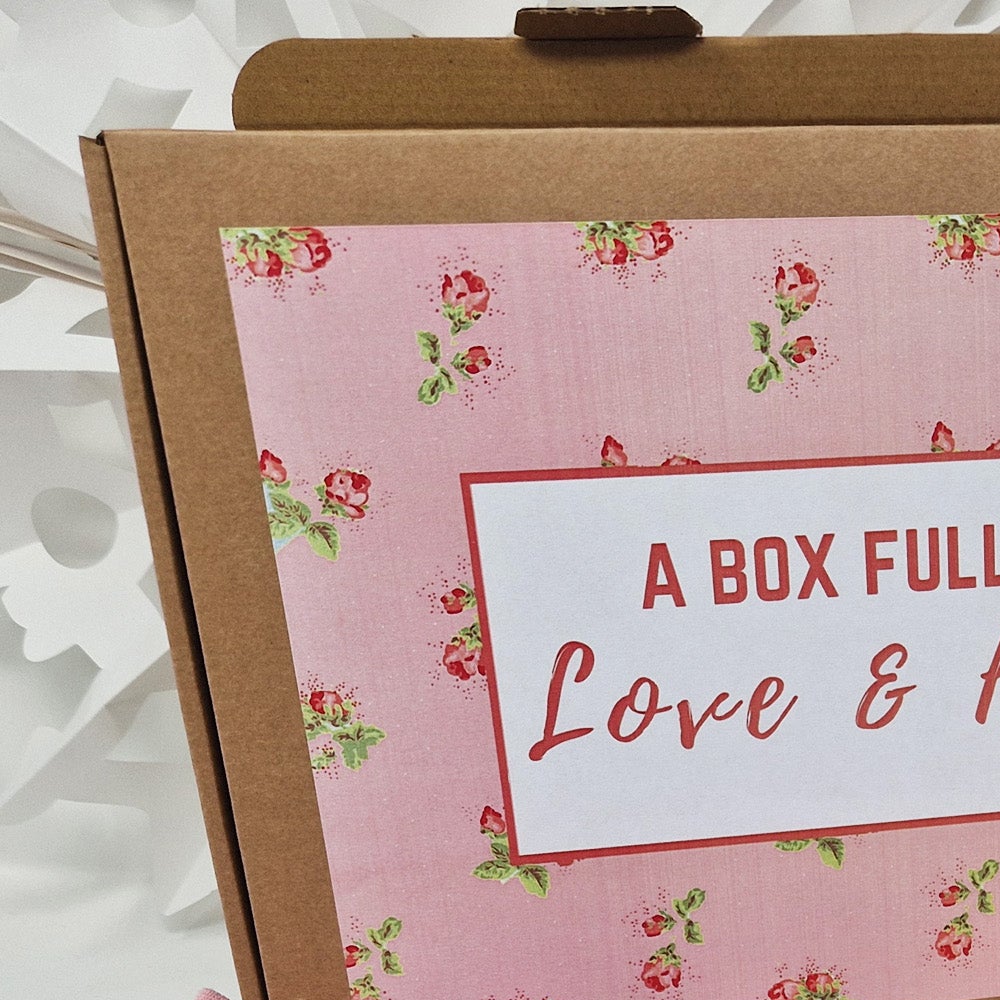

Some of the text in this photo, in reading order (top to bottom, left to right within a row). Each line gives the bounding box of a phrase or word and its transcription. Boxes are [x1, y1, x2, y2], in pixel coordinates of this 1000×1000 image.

[642, 542, 686, 609] A
[709, 532, 839, 606] BOX
[528, 640, 799, 762] Love
[855, 642, 916, 730] &
